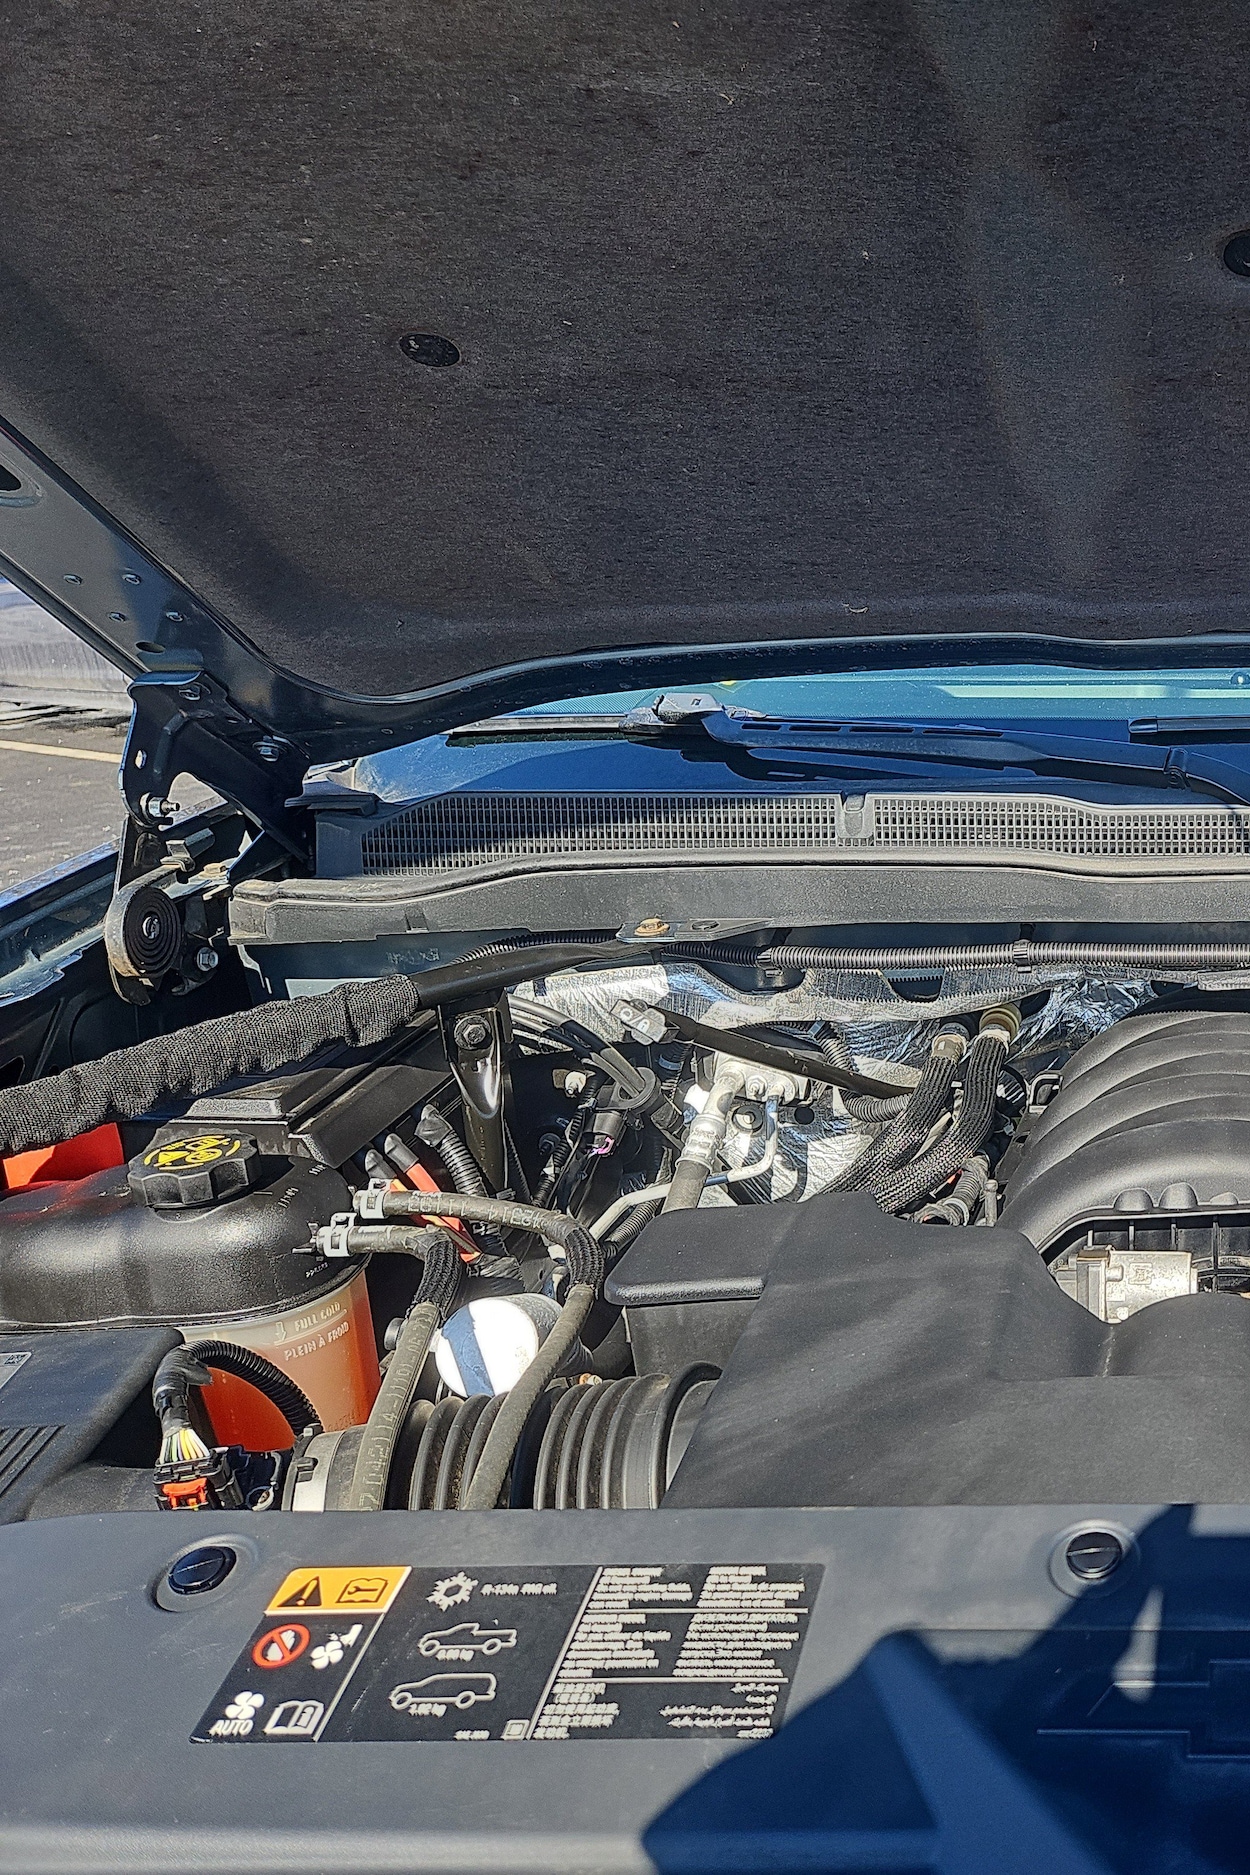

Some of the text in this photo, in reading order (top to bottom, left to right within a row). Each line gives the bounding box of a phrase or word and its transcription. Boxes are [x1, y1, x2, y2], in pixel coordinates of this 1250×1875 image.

[294, 1314, 318, 1332] FULL
[284, 1340, 318, 1361] PLEIN
[327, 1321, 350, 1343] FROID
[207, 1719, 254, 1737] AUTO
